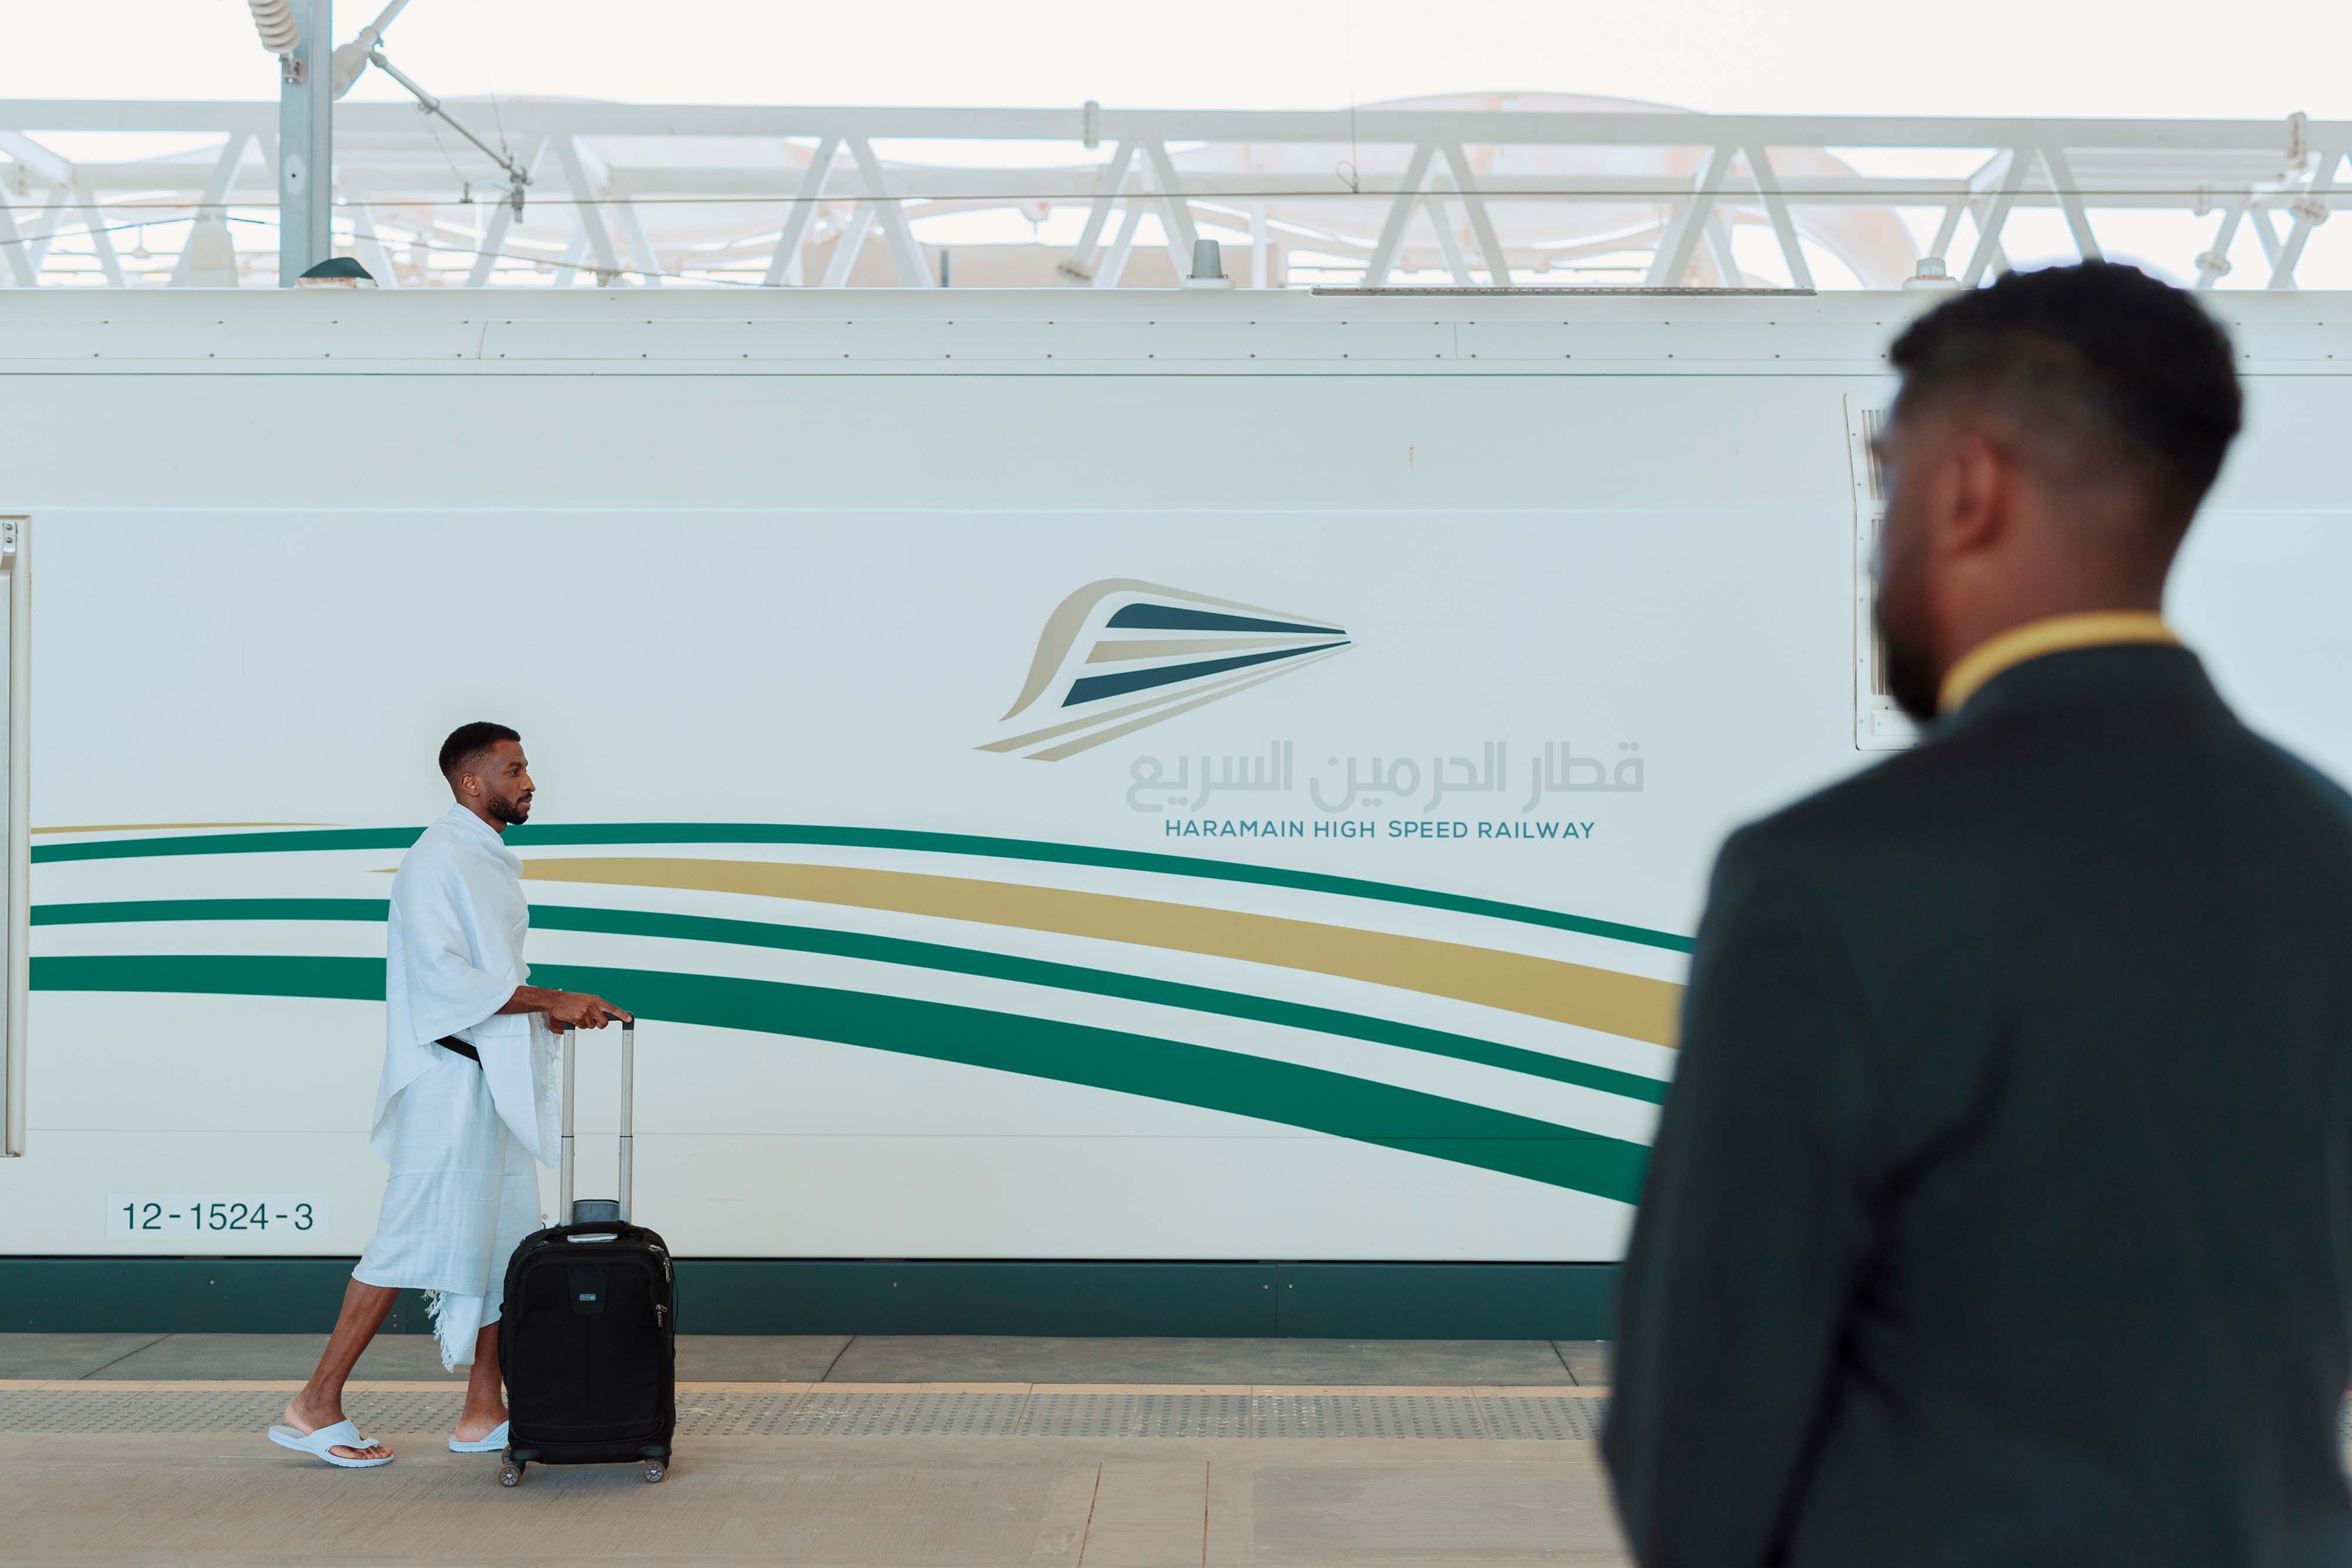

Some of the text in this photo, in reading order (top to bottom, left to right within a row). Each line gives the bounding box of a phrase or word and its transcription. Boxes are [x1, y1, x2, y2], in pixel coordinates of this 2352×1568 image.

[1125, 740, 1645, 814] قطار الحرمين السريع
[1165, 819, 1595, 840] HARAMAIN HIGH SPEED RAILWAY
